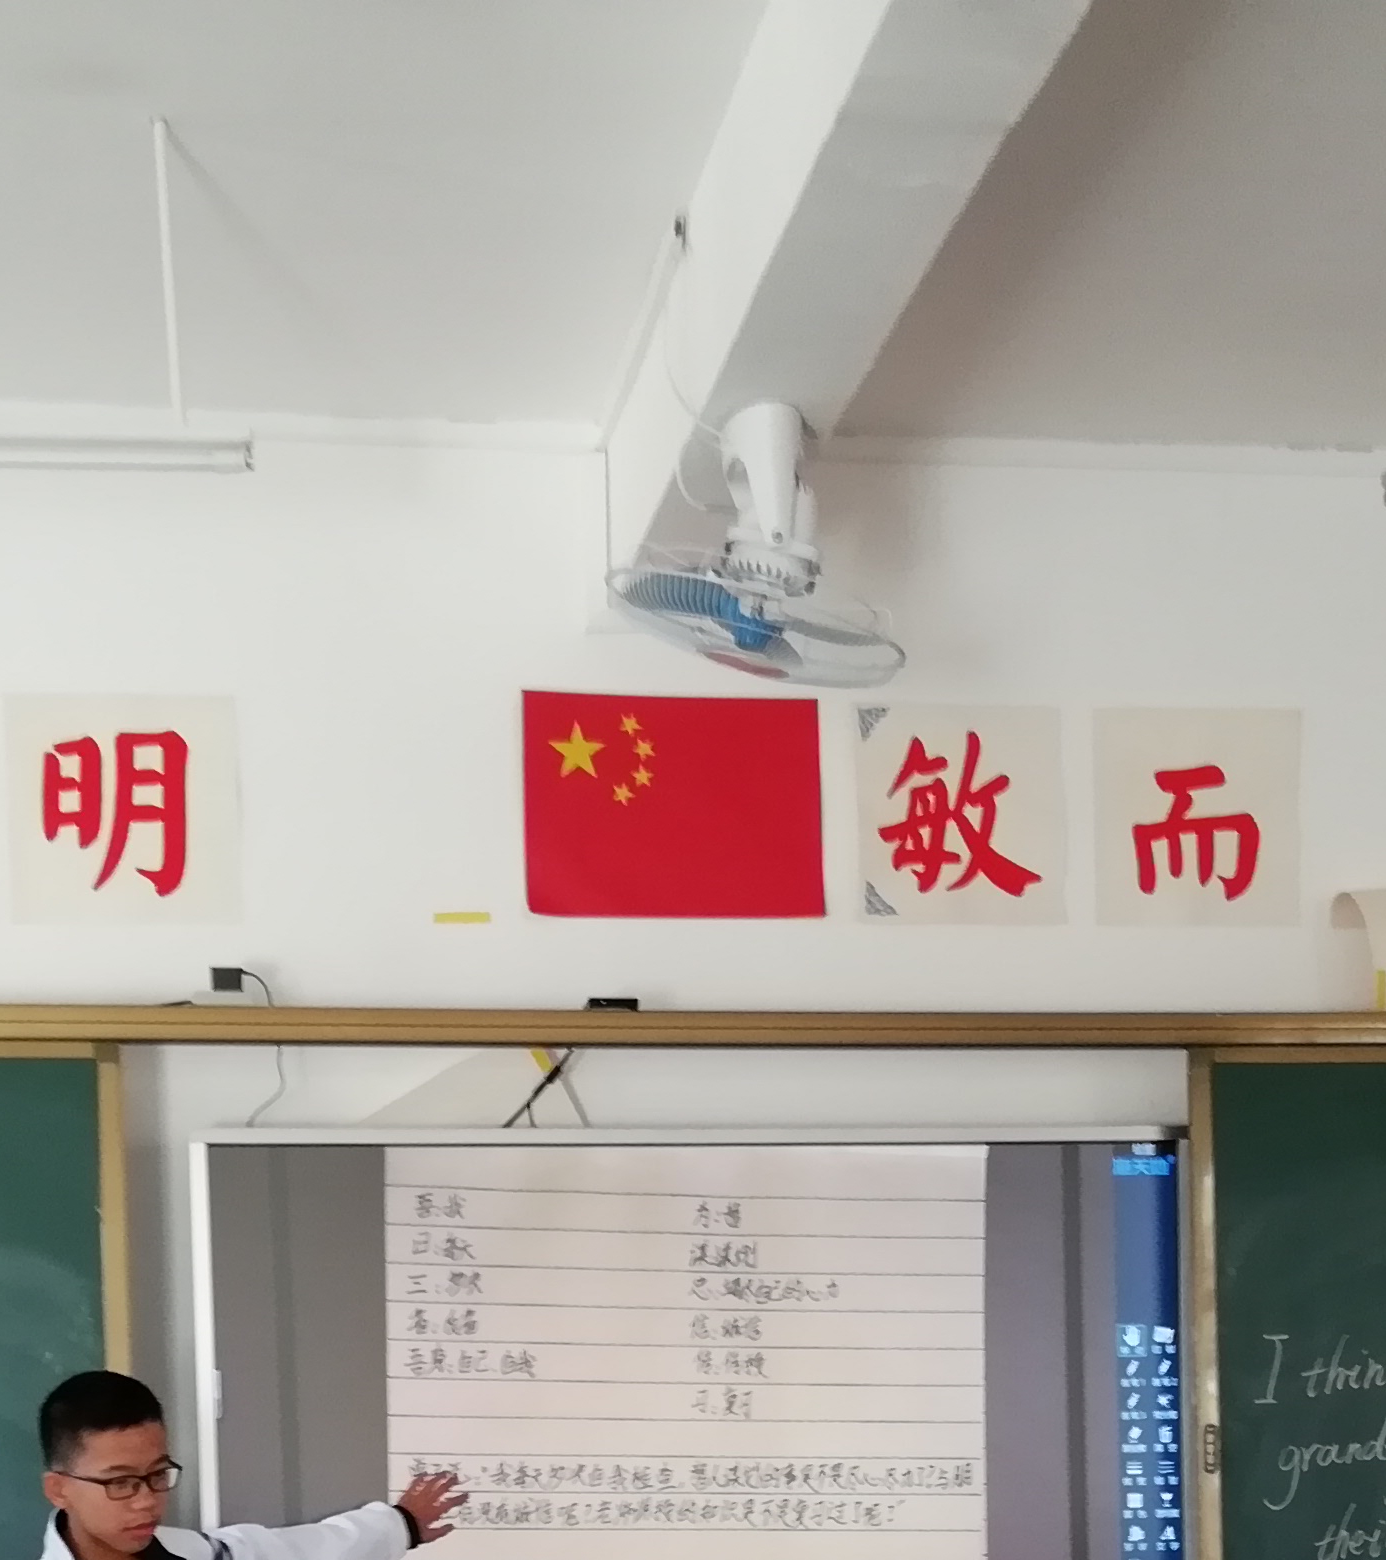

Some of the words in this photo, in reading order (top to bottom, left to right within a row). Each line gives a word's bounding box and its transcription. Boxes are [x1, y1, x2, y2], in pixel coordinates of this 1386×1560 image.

[43, 731, 188, 896] 明
[879, 733, 1040, 896] 敏
[1133, 766, 1260, 900] 而
[1254, 1334, 1289, 1404] I
